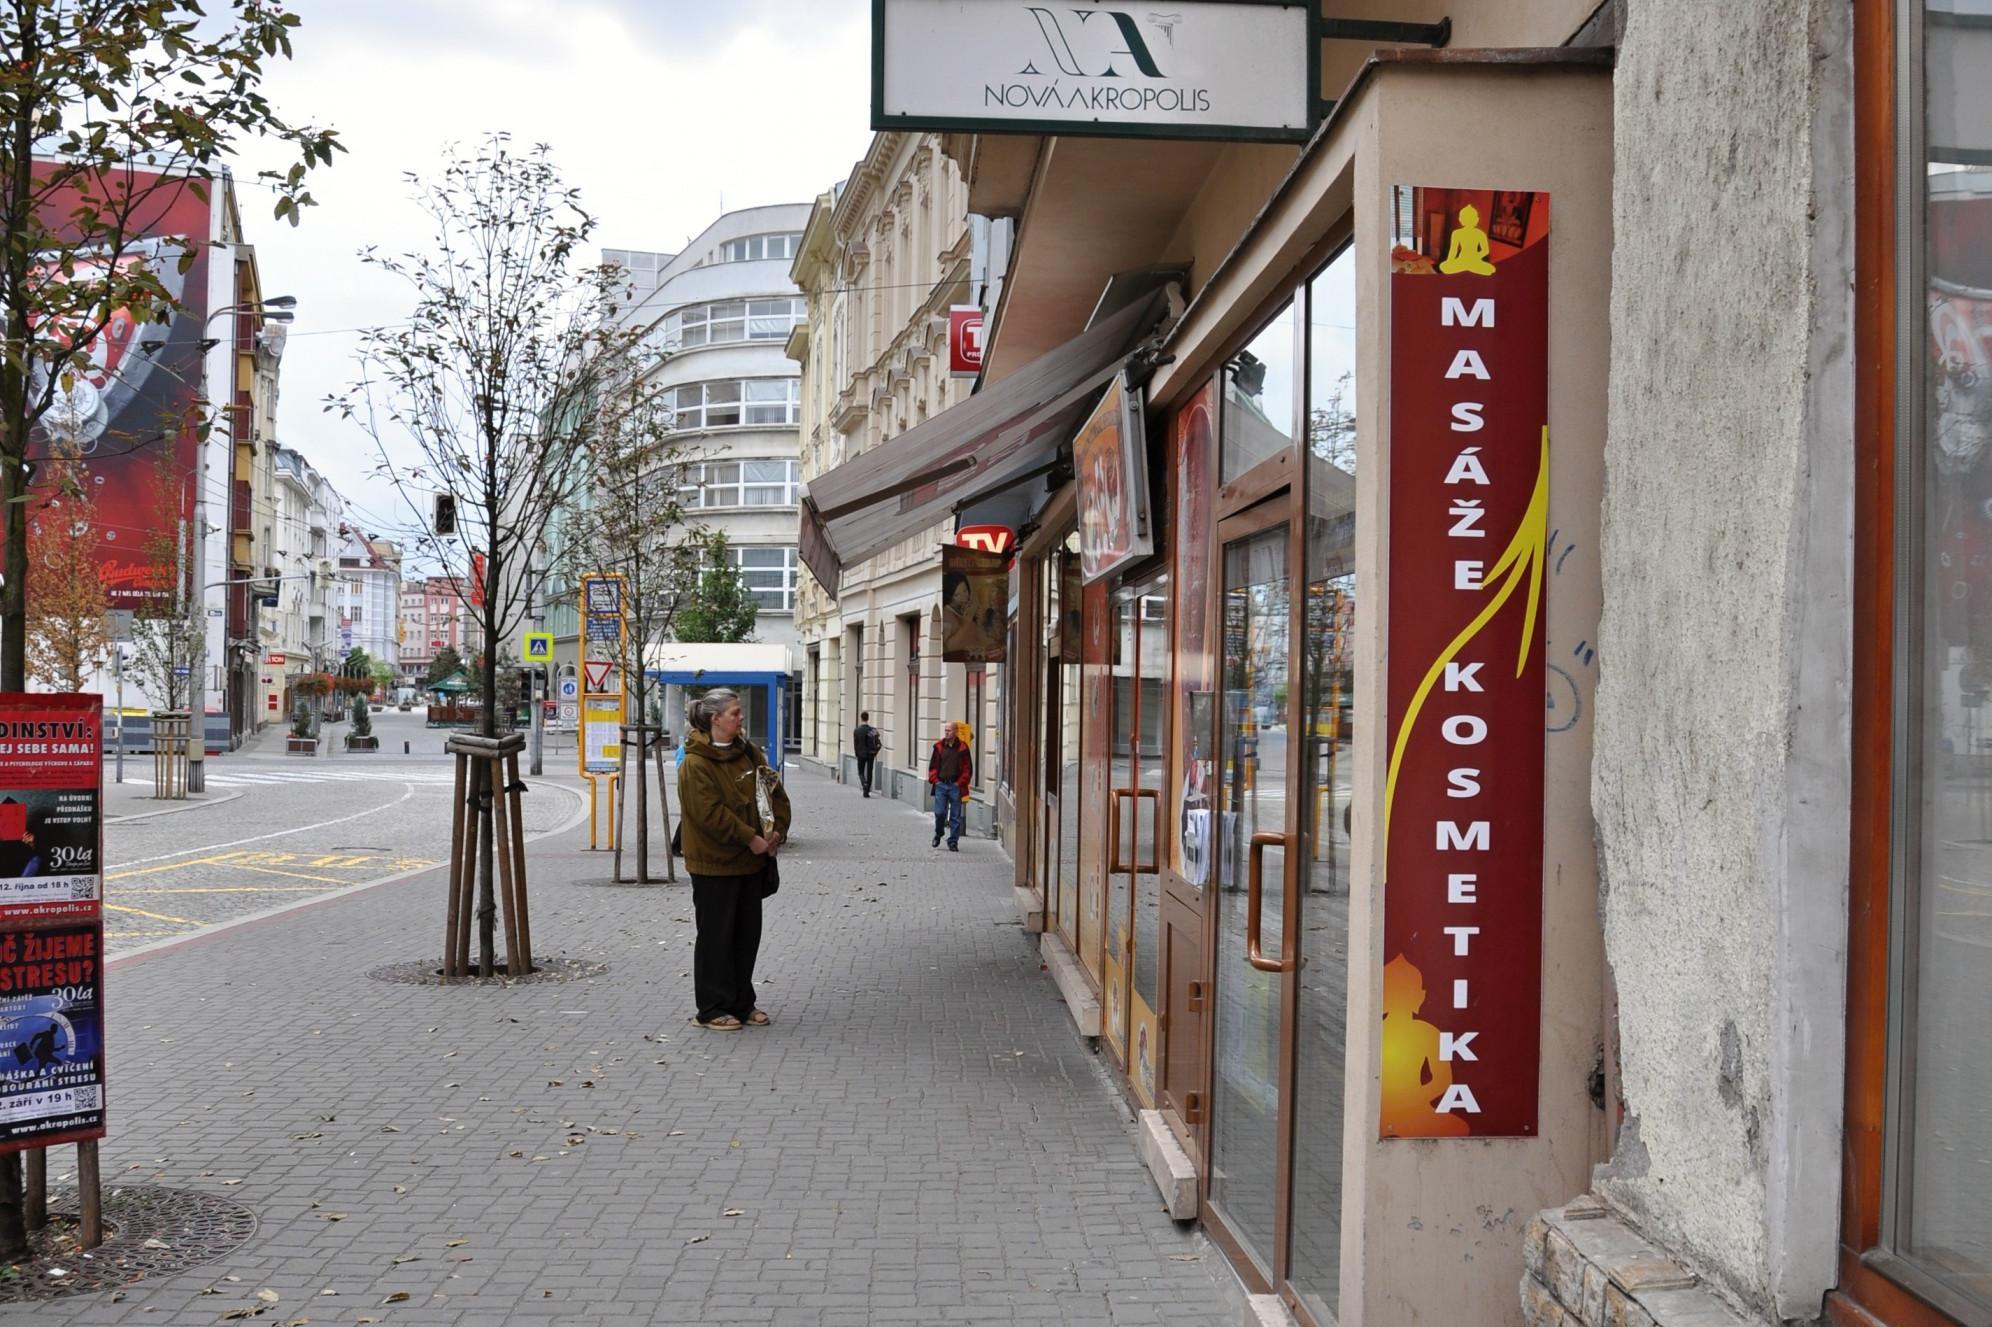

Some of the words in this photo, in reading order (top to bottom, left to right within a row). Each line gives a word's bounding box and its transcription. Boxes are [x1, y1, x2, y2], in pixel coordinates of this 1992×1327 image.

[1440, 296, 1496, 591] MASÁŽE
[961, 532, 1008, 554] TV
[17, 743, 48, 754] SEBE
[51, 743, 94, 754] SAMA!
[49, 846, 75, 868] 30
[1434, 661, 1491, 1113] KOSMETIKA
[4, 903, 93, 916] www.akropolis.cz
[0, 934, 17, 963] Č
[23, 932, 95, 962] ŽIJEME
[0, 959, 94, 991] STRESU?
[52, 986, 77, 1009] 30
[40, 1067, 46, 1077] A
[51, 1060, 94, 1075] CVIČENÍ
[58, 1073, 96, 1086] STRESU
[9, 1096, 32, 1109] září
[48, 1093, 61, 1103] 19
[65, 1092, 72, 1101] h
[11, 1116, 98, 1134] www.akropolis.cz
